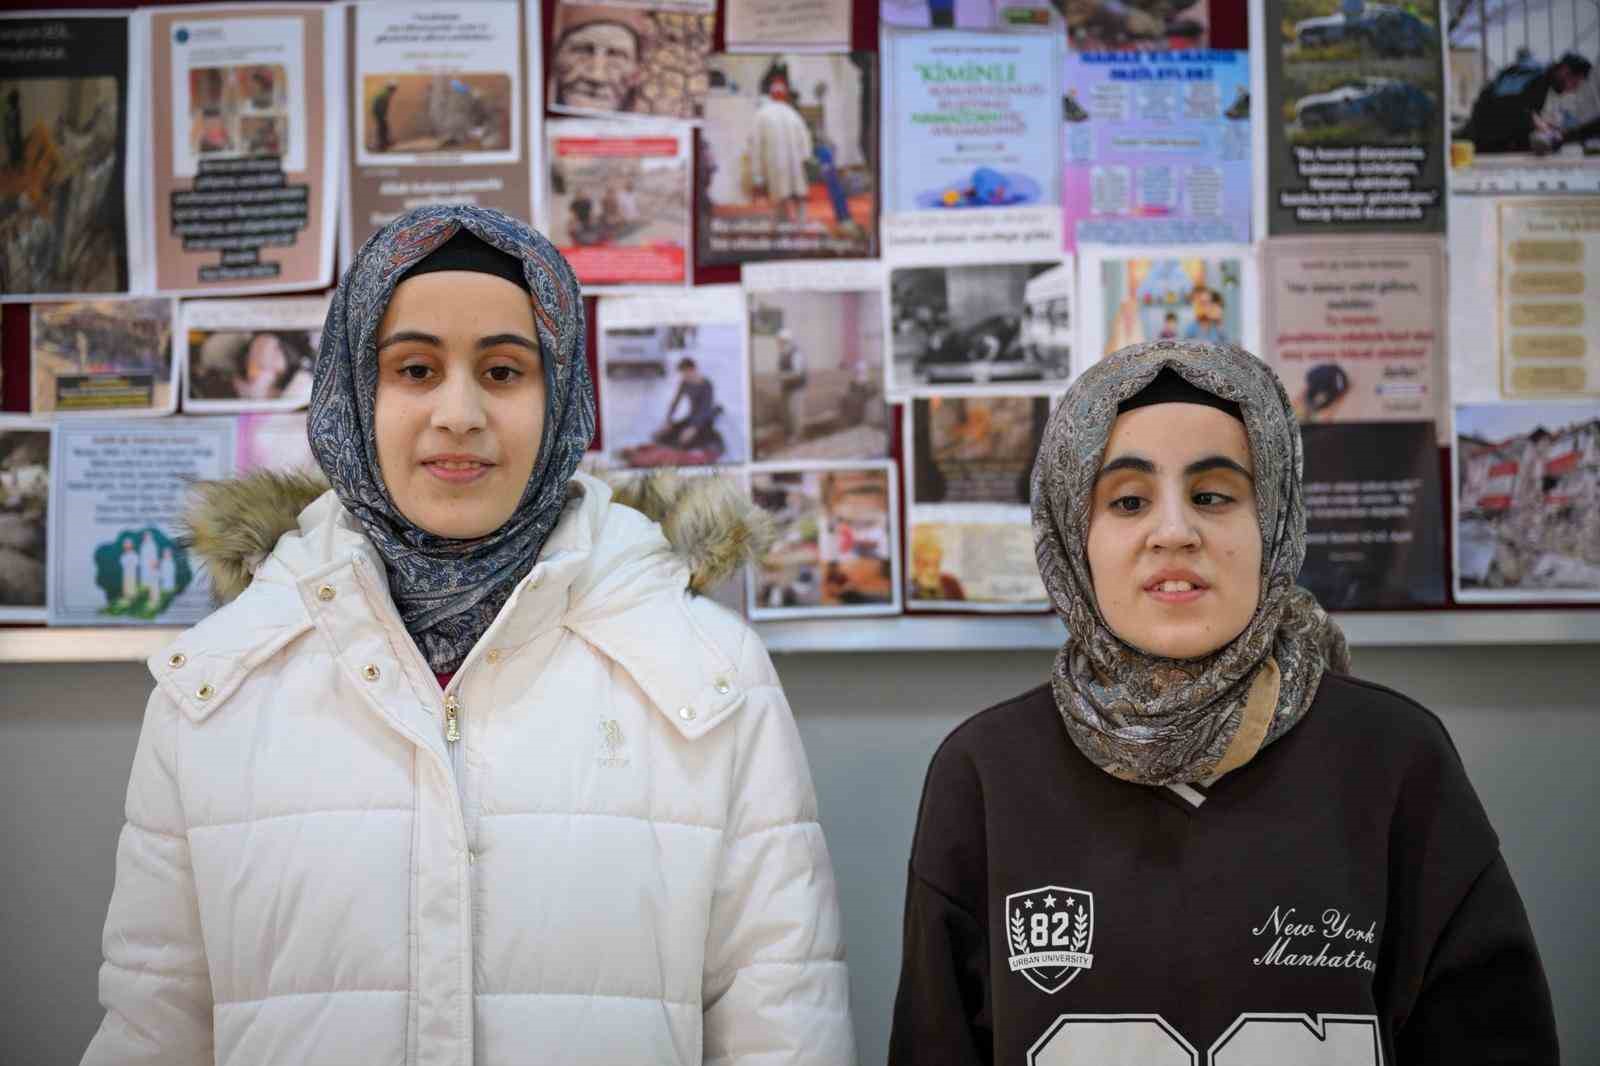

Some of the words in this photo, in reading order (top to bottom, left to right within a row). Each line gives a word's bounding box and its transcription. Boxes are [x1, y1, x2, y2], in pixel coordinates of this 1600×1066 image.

[1030, 911, 1070, 947] 82
[1251, 905, 1317, 936] New
[1321, 908, 1377, 944] York
[1012, 956, 1040, 968] URBAN
[1041, 953, 1089, 965] UNIVERSITY
